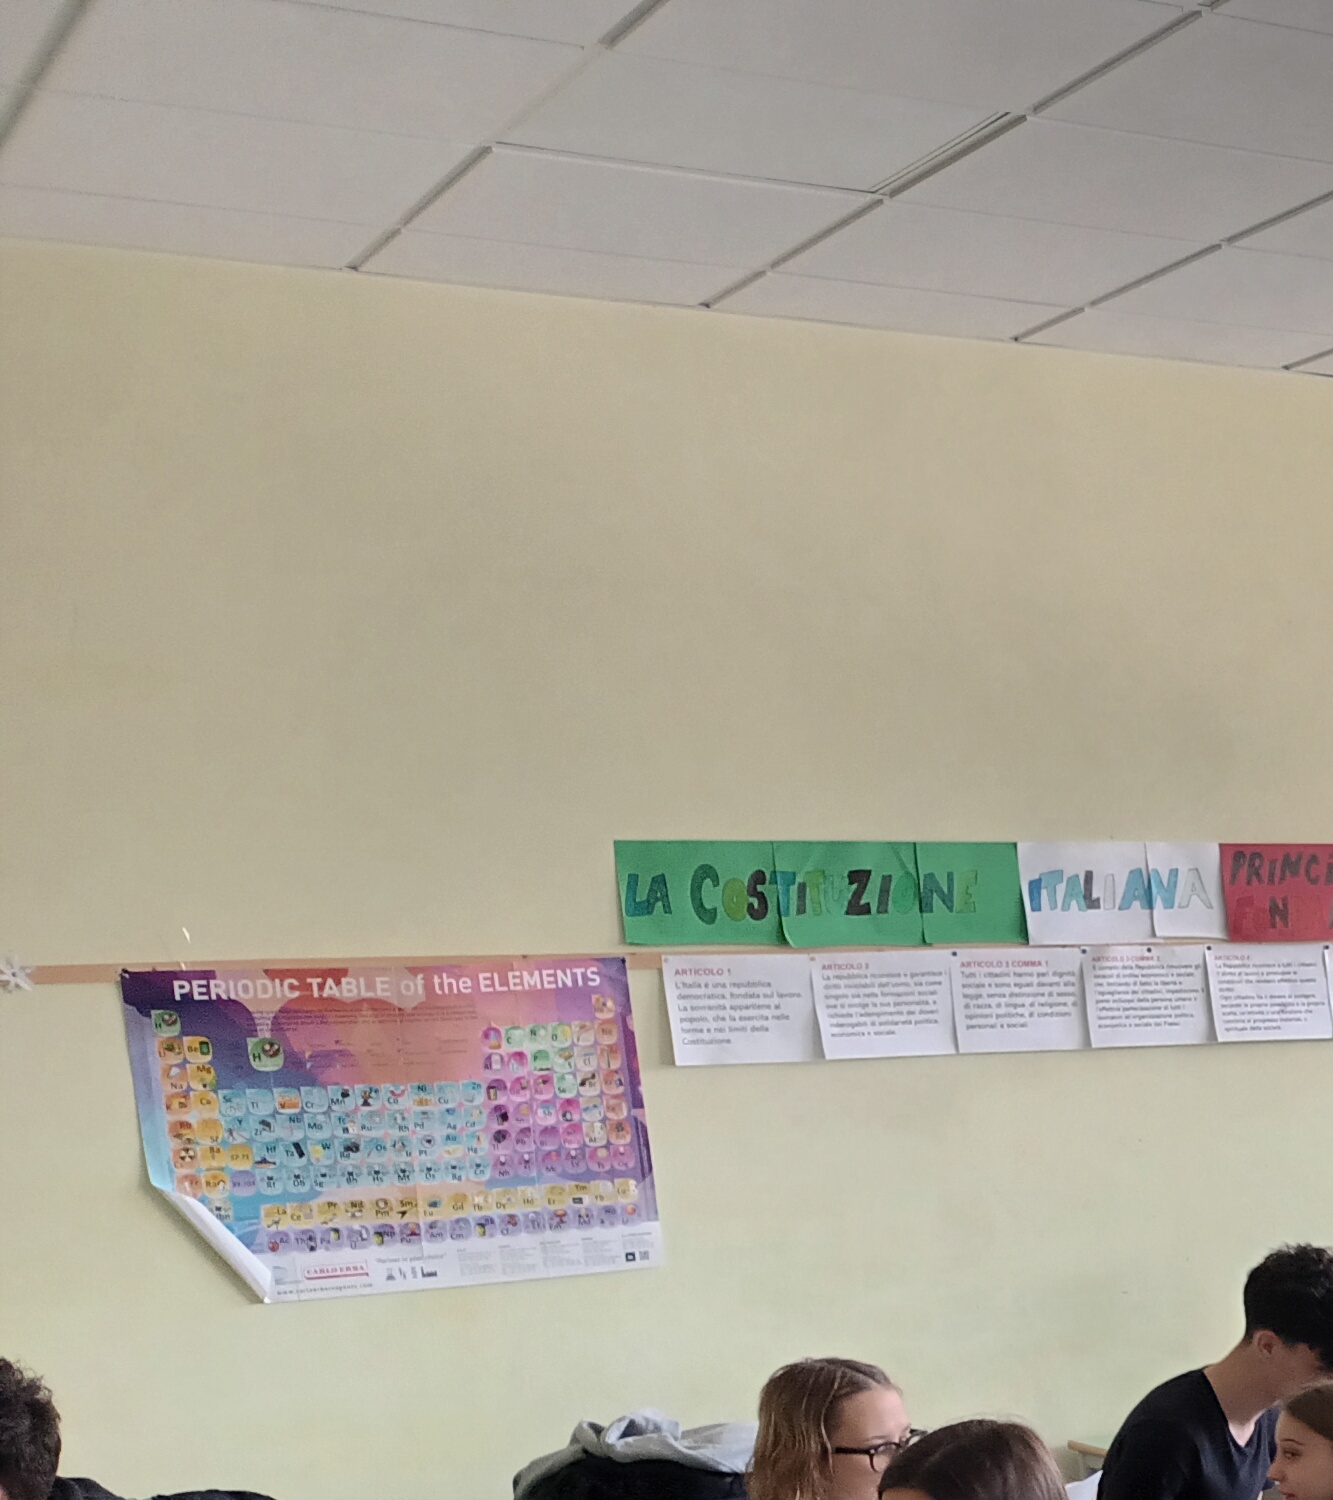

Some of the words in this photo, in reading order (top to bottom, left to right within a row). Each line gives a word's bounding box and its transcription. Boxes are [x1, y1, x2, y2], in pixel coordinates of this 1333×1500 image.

[625, 873, 672, 917] LA
[690, 863, 978, 925] COSTITUZIONE
[1027, 867, 1214, 912] ITALIANA
[173, 977, 300, 1001] PERIODIC
[307, 977, 391, 997] TABLE
[401, 975, 424, 994] of
[433, 972, 472, 995] the
[479, 967, 601, 992] ELEMENTS
[674, 968, 724, 976] ARTICOLO
